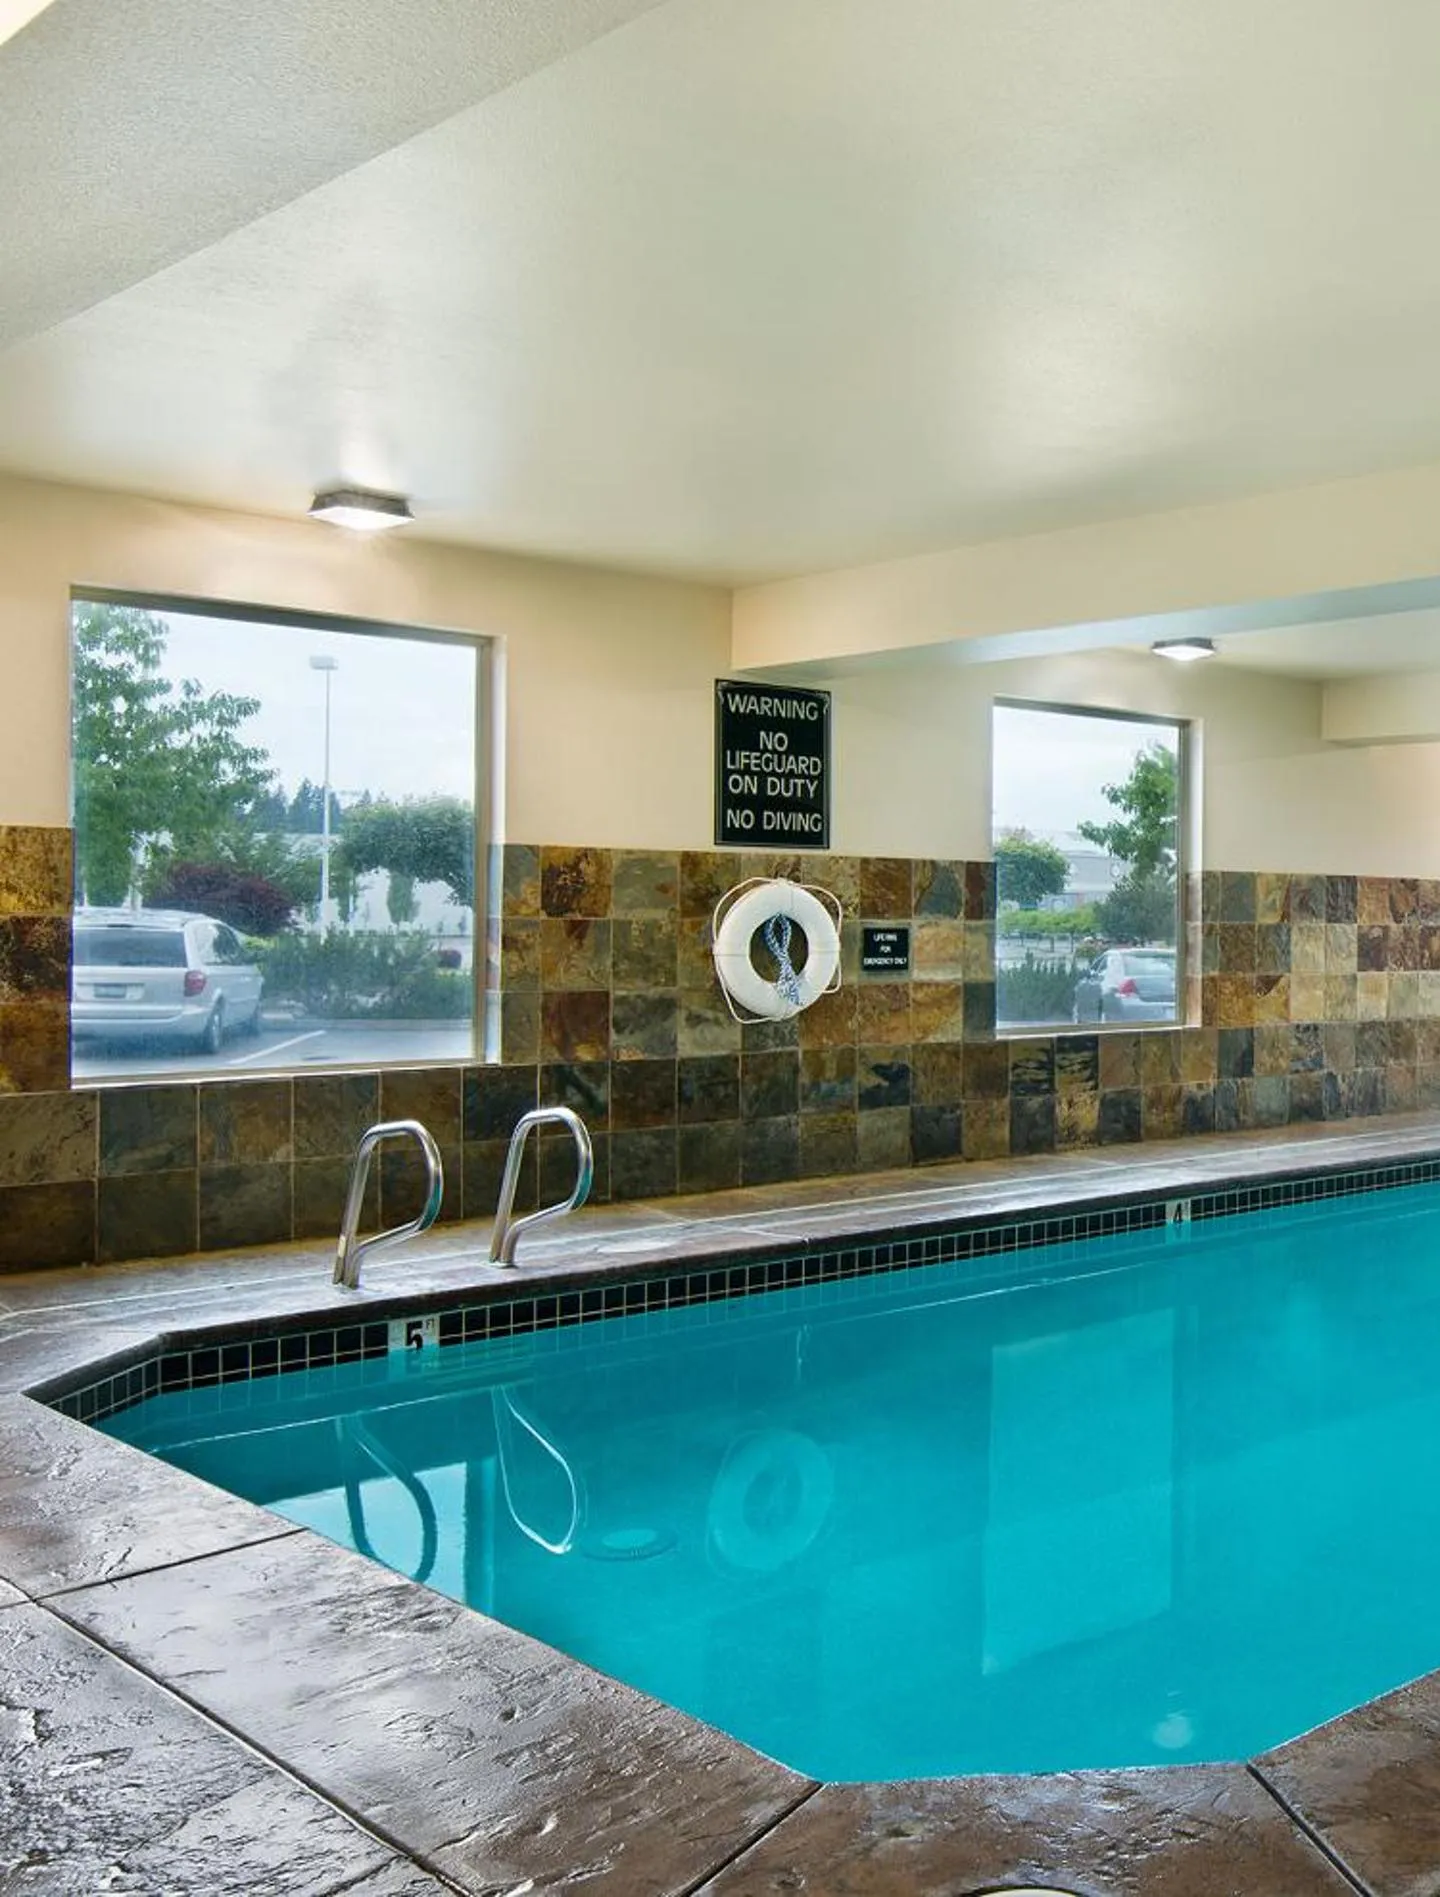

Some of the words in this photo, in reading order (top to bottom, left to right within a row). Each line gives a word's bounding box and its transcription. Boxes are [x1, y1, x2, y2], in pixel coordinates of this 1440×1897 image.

[727, 693, 819, 721] WARNING
[759, 730, 789, 751] NO
[726, 749, 822, 776] LIFEGUARD
[728, 774, 758, 795] ON
[767, 776, 818, 799] DUTY
[726, 808, 755, 829] NO
[763, 810, 823, 832] DIVING
[406, 1320, 424, 1351] 5
